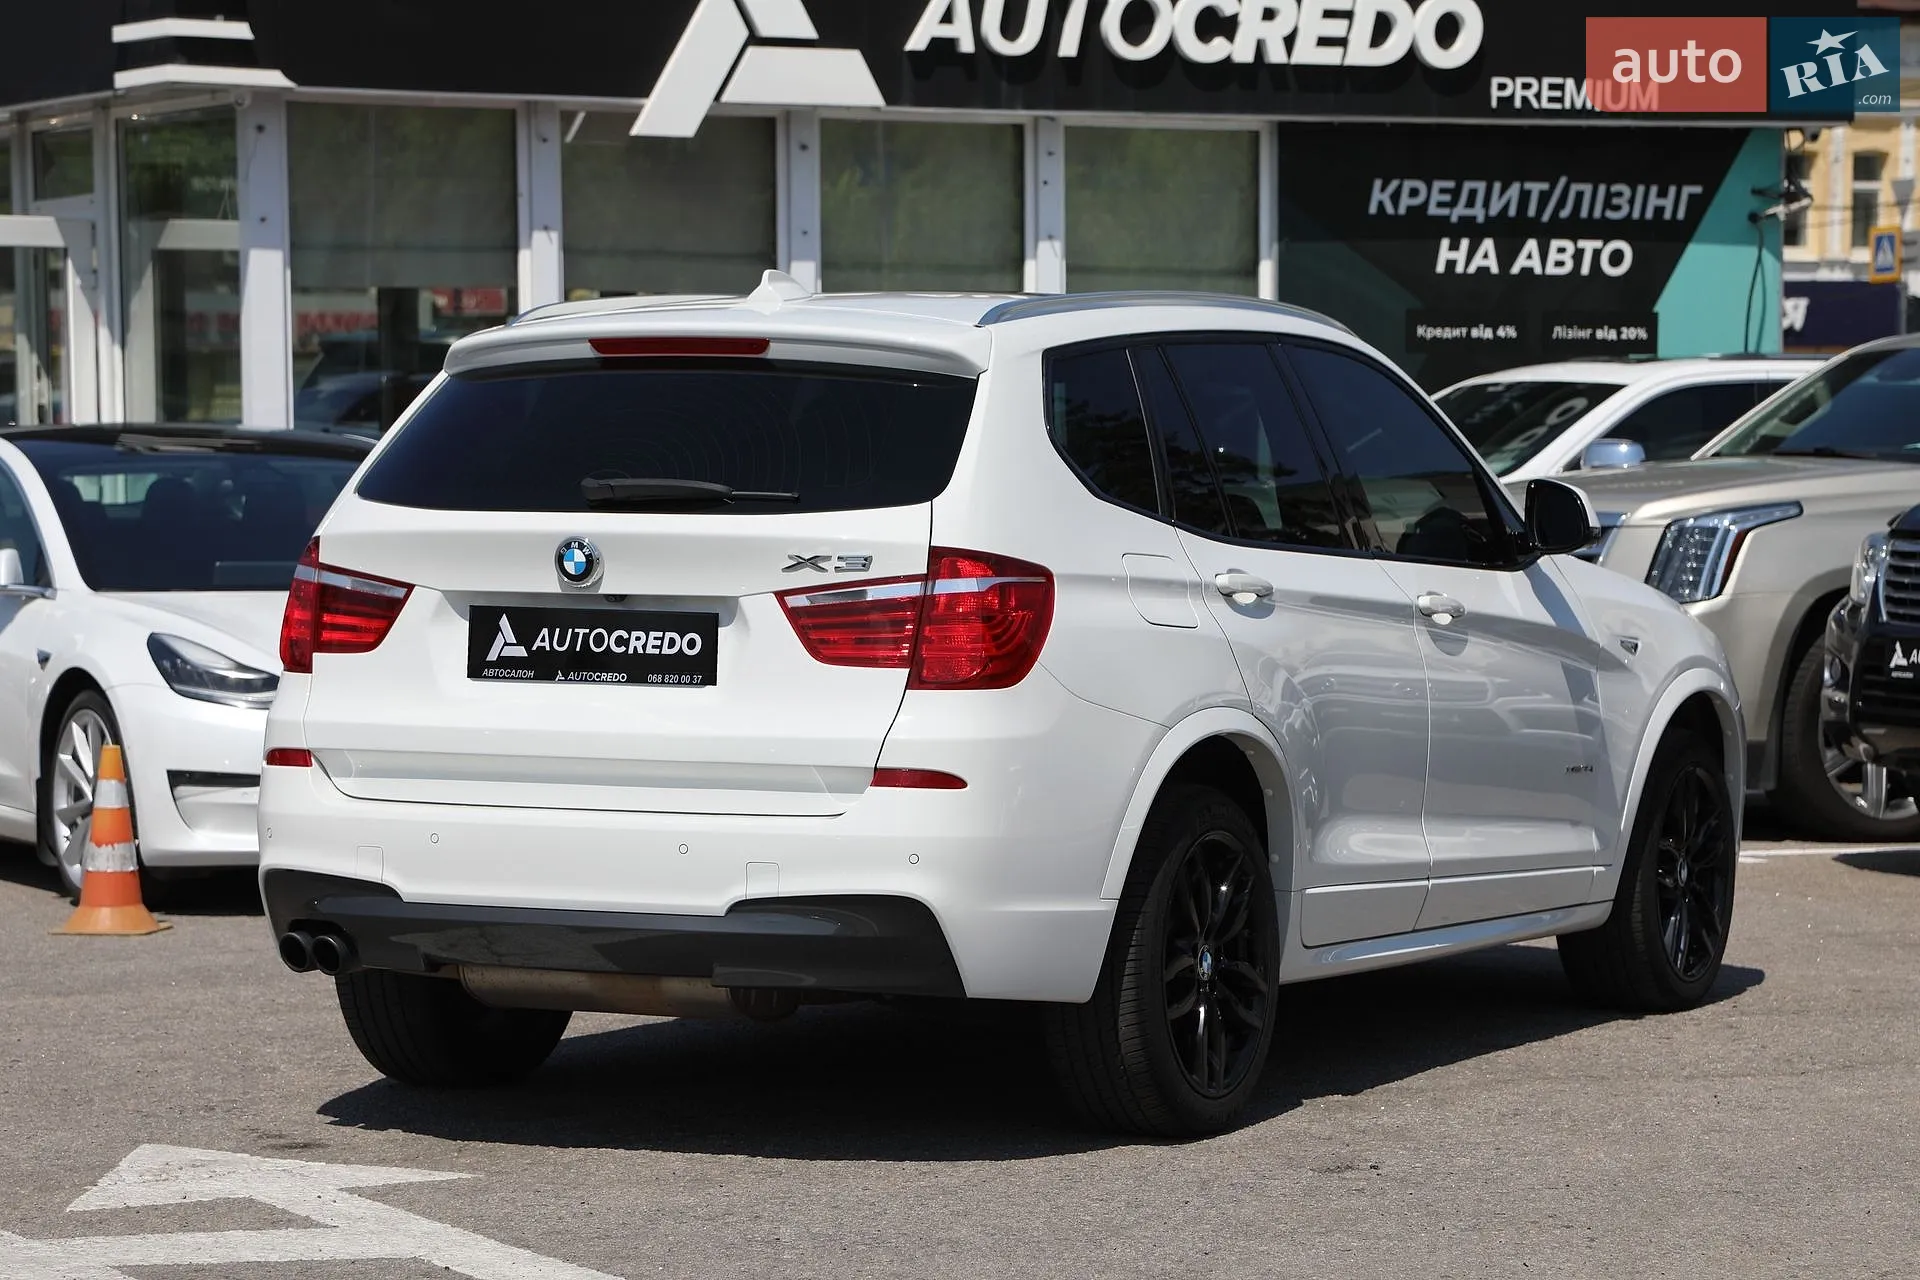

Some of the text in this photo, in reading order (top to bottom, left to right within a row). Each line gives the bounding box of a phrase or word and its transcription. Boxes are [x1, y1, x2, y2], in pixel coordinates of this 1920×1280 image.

[903, 0, 1484, 69] AUTOCREDO
[1489, 76, 1659, 111] PREMIUM
[1368, 176, 1703, 222] КРЕДИТ/ЛІЗІНГ
[1435, 237, 1634, 277] НА АВТО
[1416, 324, 1468, 340] Кредит
[1496, 324, 1518, 340] 4%
[1551, 324, 1593, 340] Лізінг
[1620, 325, 1649, 341] 20%
[781, 554, 873, 573] X3
[532, 628, 702, 656] AUTOCREDO
[481, 668, 535, 679] АВТОСАЛОН
[568, 672, 627, 682] AUTOCREDO
[647, 673, 702, 684] 068 820 00 37
